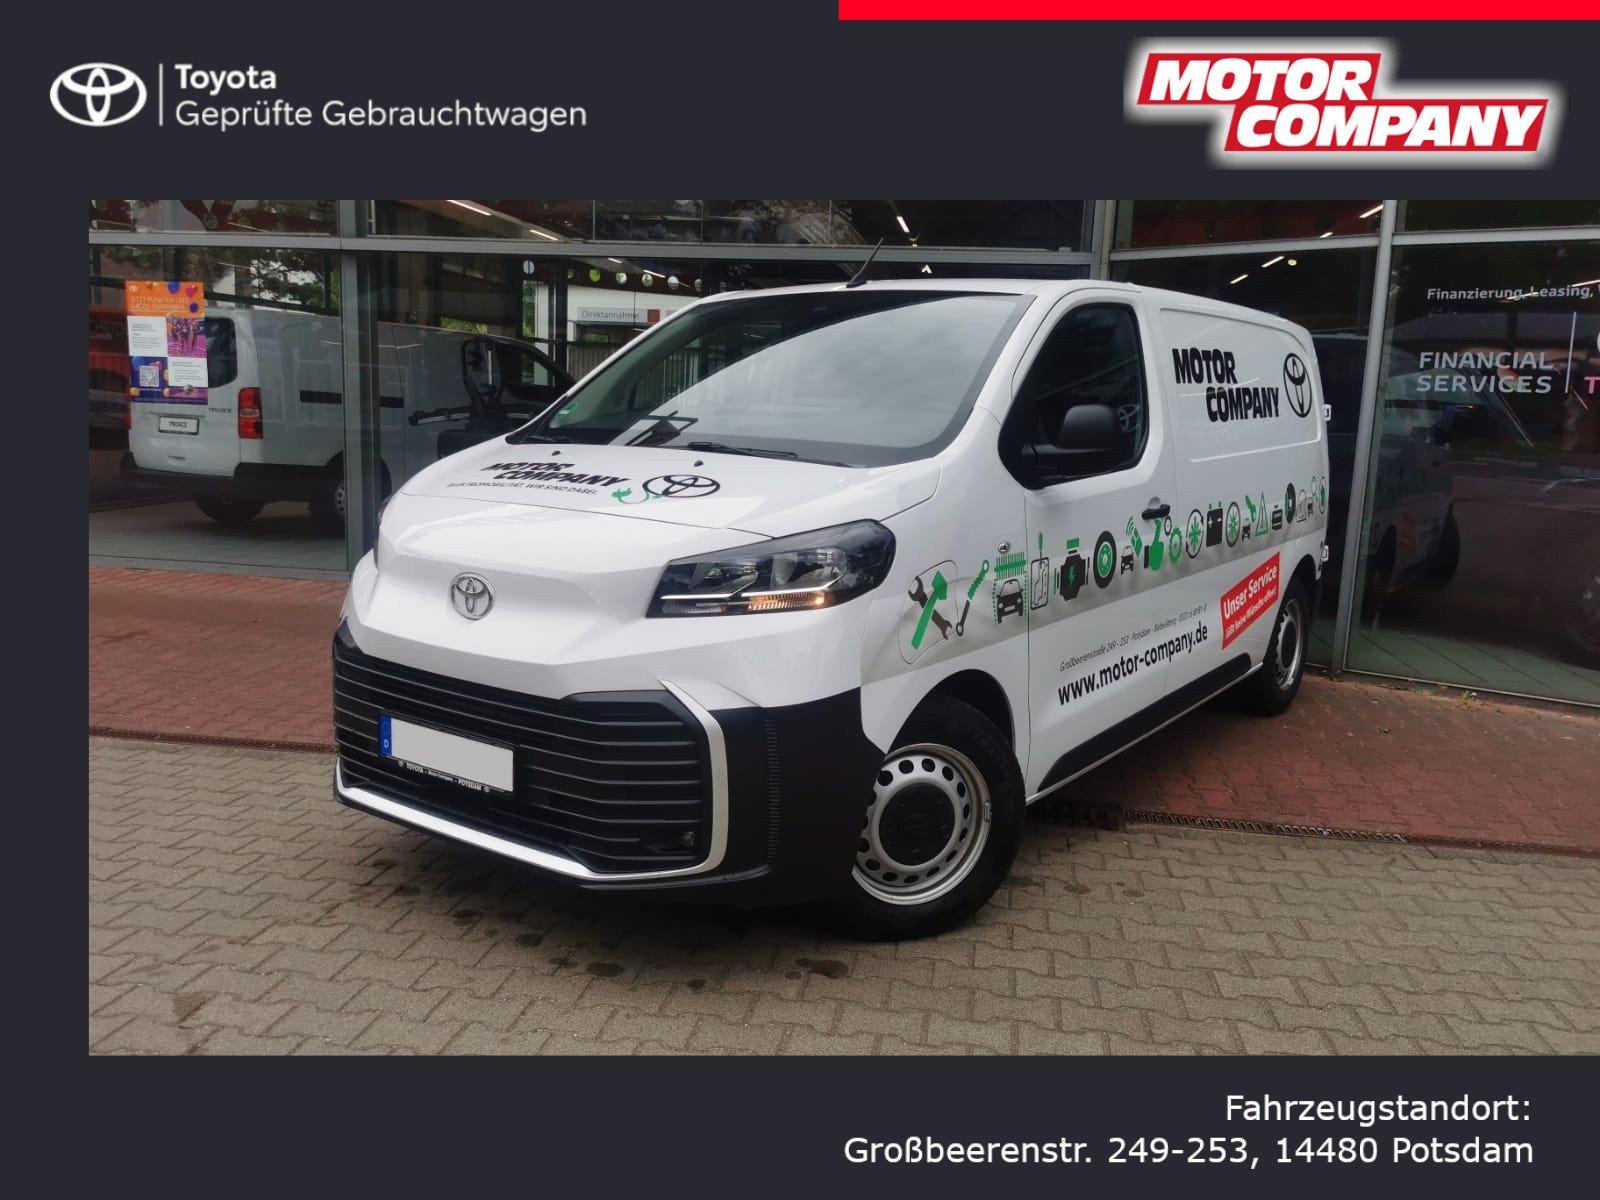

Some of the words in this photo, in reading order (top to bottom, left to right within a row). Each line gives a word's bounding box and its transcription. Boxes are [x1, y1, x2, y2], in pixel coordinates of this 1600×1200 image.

[1427, 287, 1526, 300] Finanzierung,
[1530, 285, 1594, 299] Leasing,
[581, 309, 640, 320] Direktannahme
[1172, 347, 1238, 384] MOTOR
[1419, 351, 1554, 369] FINANCIAL
[1416, 374, 1552, 394] SERVICES
[1206, 386, 1280, 423] COMPANY
[480, 462, 576, 472] MOTOR
[493, 470, 632, 487] COMPANY
[1224, 587, 1248, 619] Unser
[1248, 566, 1277, 598] Service
[1058, 619, 1208, 706] www.motor-company.de
[384, 739, 389, 748] D
[406, 762, 424, 774] TOYOTA
[458, 778, 482, 791] POTSDAM
